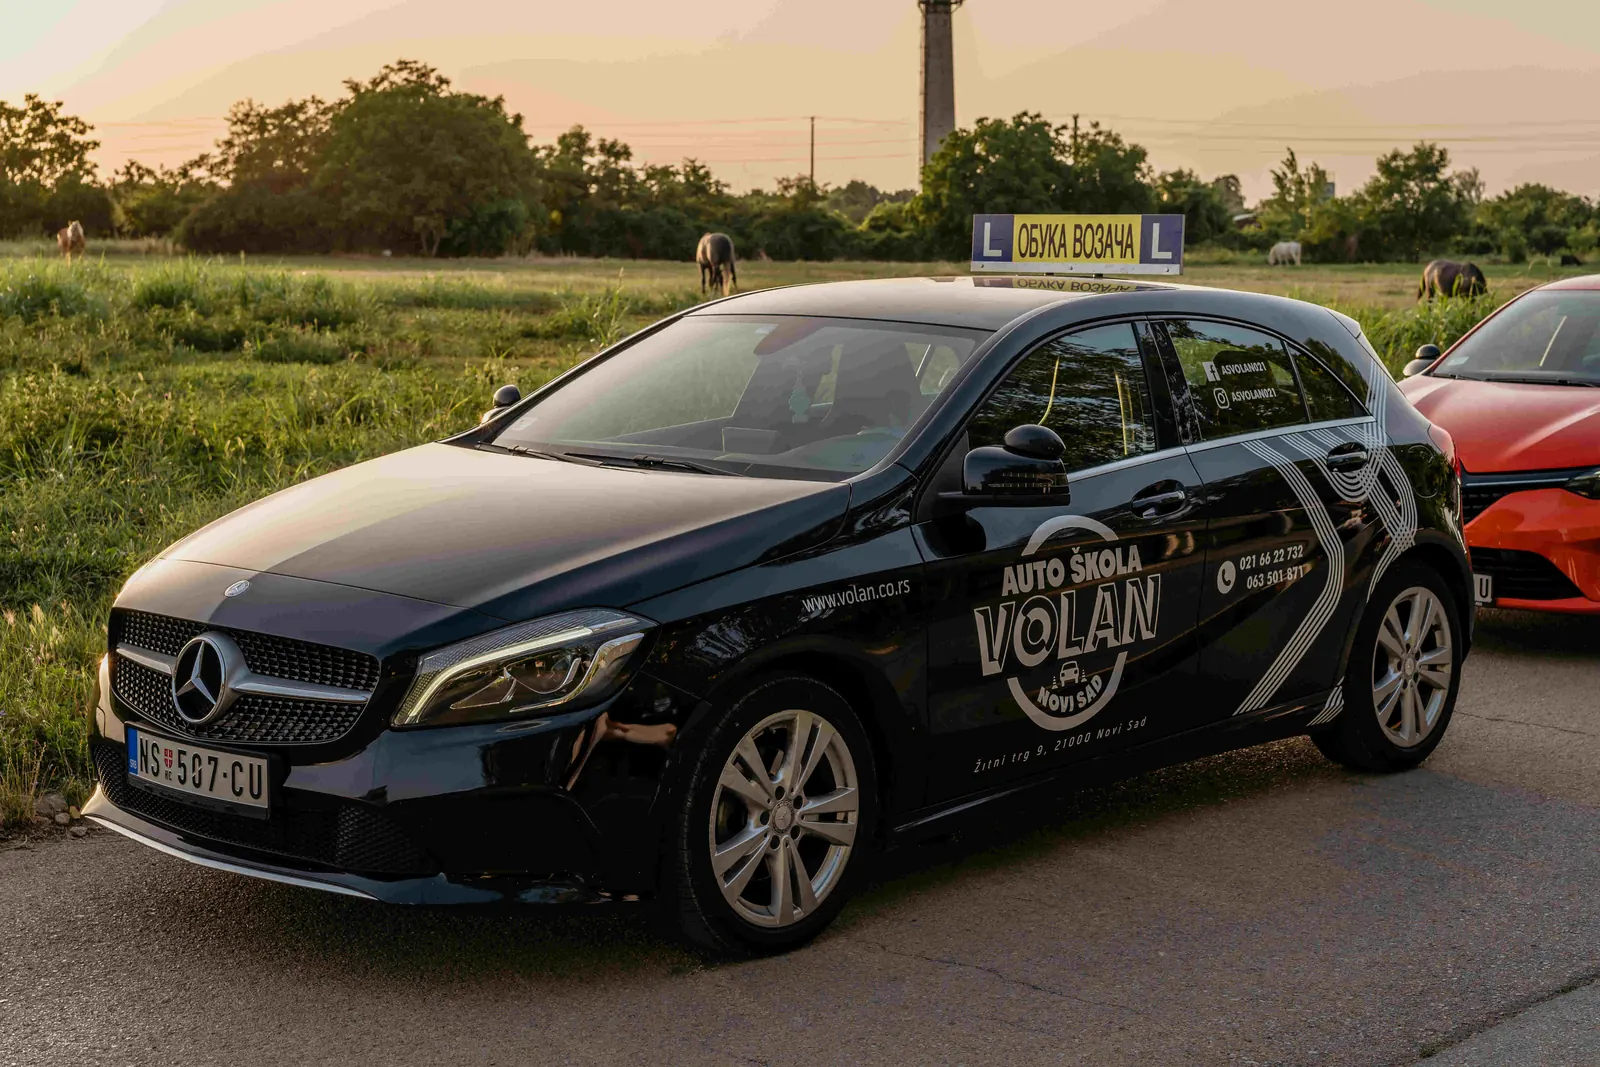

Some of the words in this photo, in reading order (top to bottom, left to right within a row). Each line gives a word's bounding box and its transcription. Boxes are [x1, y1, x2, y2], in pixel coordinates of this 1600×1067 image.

[983, 222, 1002, 257] L
[1018, 223, 1067, 258] ОБУКА
[1073, 223, 1135, 259] ВОЗАЧА
[1151, 222, 1172, 259] L
[1221, 361, 1267, 375] ASVOLAN021
[1231, 387, 1277, 402] ASVOLAN021
[1001, 558, 1065, 597] AUTO
[1070, 545, 1142, 584] ŠKOLA
[1240, 554, 1256, 571] 021
[1260, 551, 1271, 566] 66
[1273, 548, 1284, 563] 22
[1287, 544, 1304, 560] 732
[1246, 573, 1264, 589] 063
[1267, 569, 1283, 585] 501
[1286, 564, 1303, 580] 871
[802, 579, 911, 613] www.volan.co.rs
[973, 573, 1161, 676] VOLAN
[1037, 685, 1074, 713] NOVI
[1076, 674, 1103, 708] SAD
[140, 736, 160, 777] NS
[1012, 750, 1030, 762] trg
[1036, 744, 1048, 756] 9,
[1054, 731, 1092, 751] 21000
[1096, 723, 1122, 739] Novi
[1126, 716, 1148, 731] Sad
